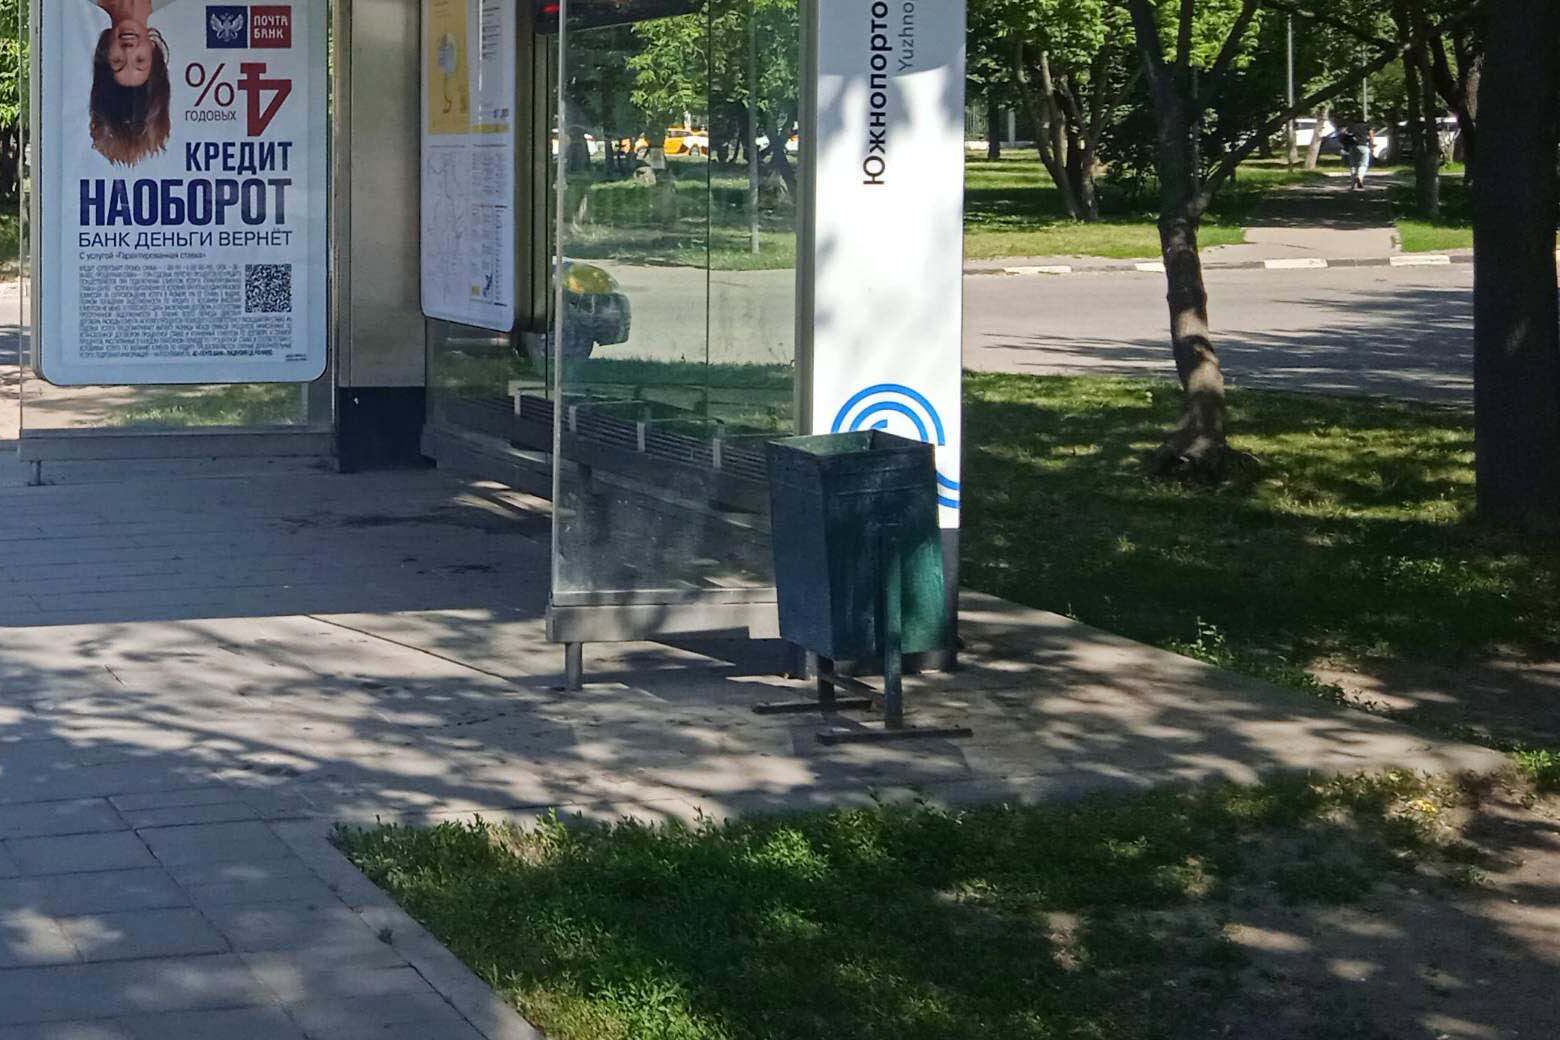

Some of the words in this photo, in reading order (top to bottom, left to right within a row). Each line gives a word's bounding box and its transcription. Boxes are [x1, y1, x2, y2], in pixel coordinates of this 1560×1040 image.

[253, 15, 288, 27] ПОЧТА
[253, 28, 284, 39] БАНК
[185, 141, 293, 175] КРЕДИТ
[79, 178, 293, 226] НАОБОРОТ
[78, 232, 130, 247] БАНК
[134, 231, 213, 250] ДЕНЬГИ
[219, 228, 293, 247] ВЕРНЁТ
